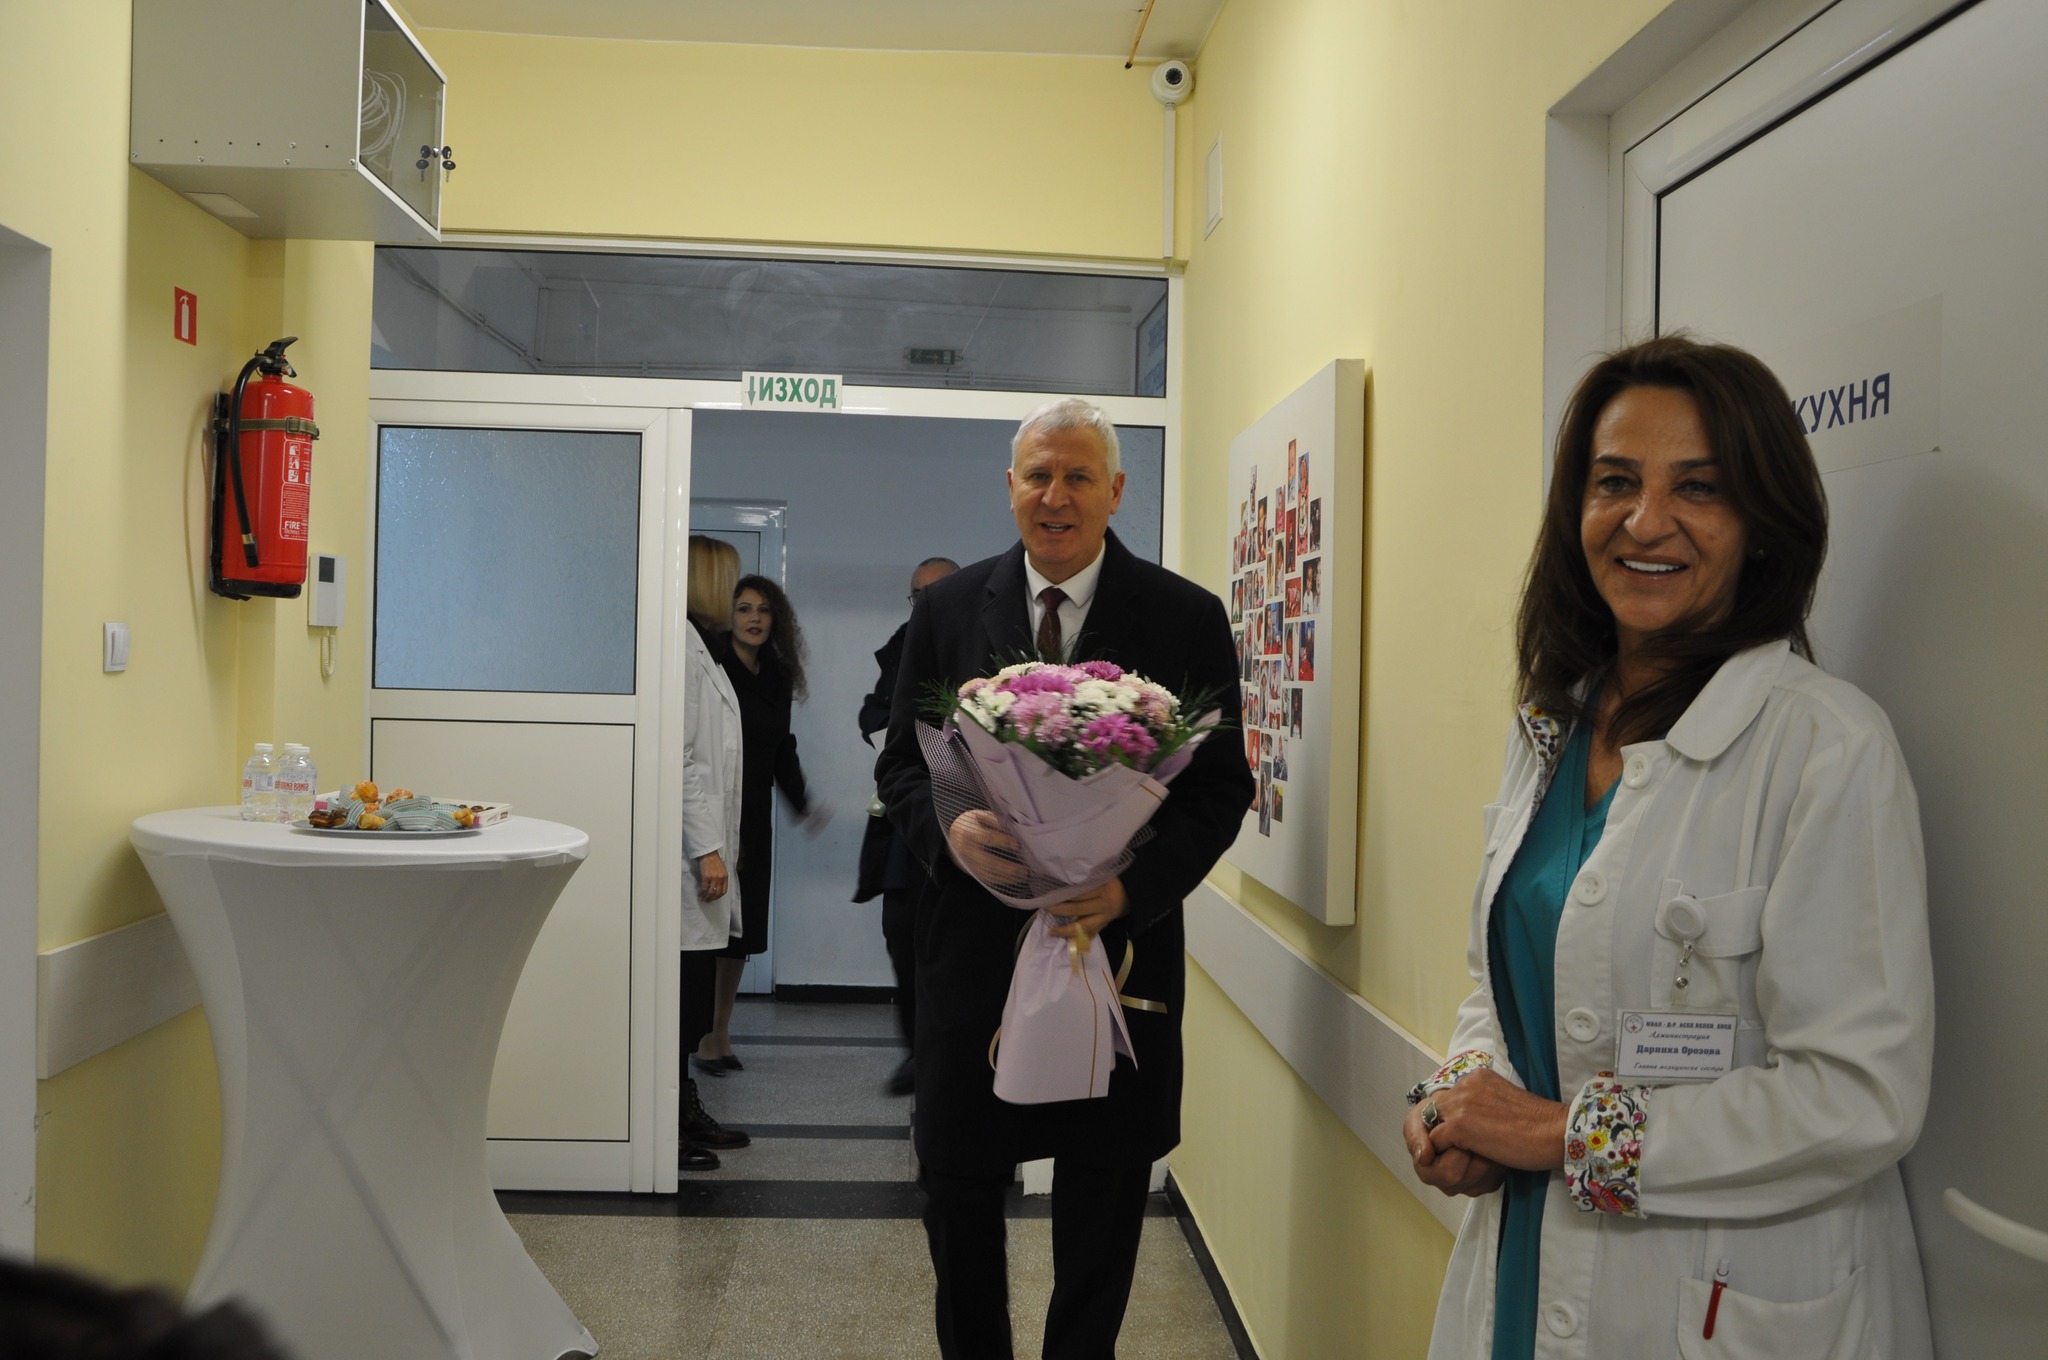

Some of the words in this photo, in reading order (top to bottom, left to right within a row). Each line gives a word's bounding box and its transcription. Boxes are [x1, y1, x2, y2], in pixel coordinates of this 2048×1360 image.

[759, 377, 836, 408] ИЗХОД
[1791, 372, 1890, 436] КУХНЯ
[1649, 1031, 1710, 1040] Администрация
[1681, 1046, 1721, 1056] Орозова
